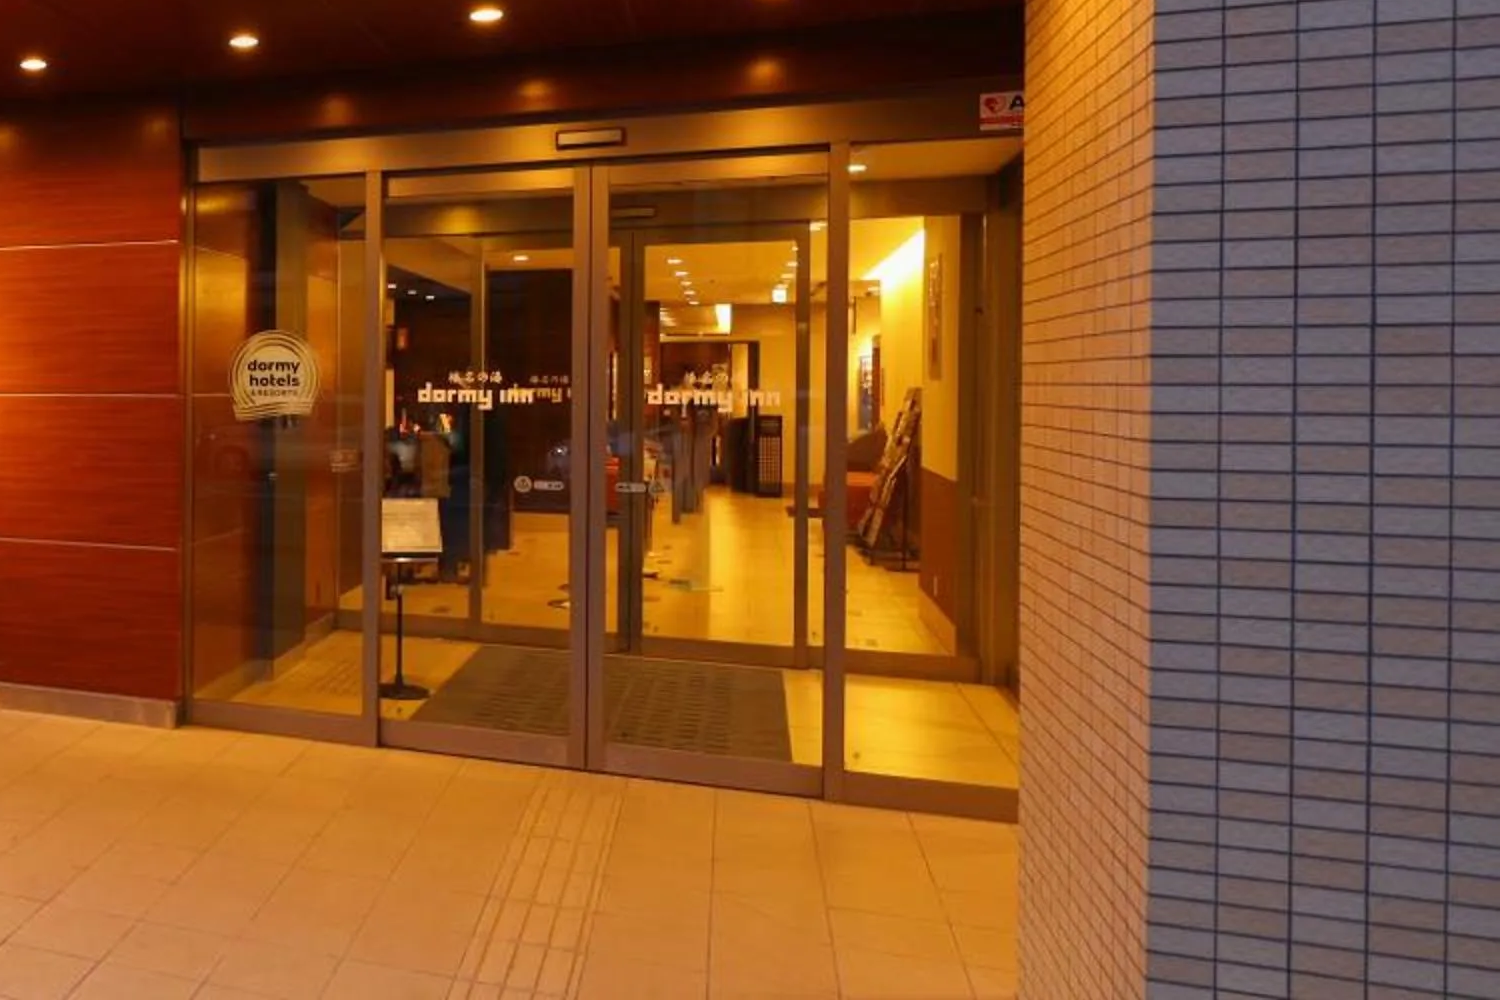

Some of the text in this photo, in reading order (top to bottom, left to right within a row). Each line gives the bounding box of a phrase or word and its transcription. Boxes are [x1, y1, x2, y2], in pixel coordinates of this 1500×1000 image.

[247, 360, 300, 373] dormy
[249, 374, 300, 386] hotels
[417, 382, 493, 411] dormy
[647, 383, 733, 413] dormy
